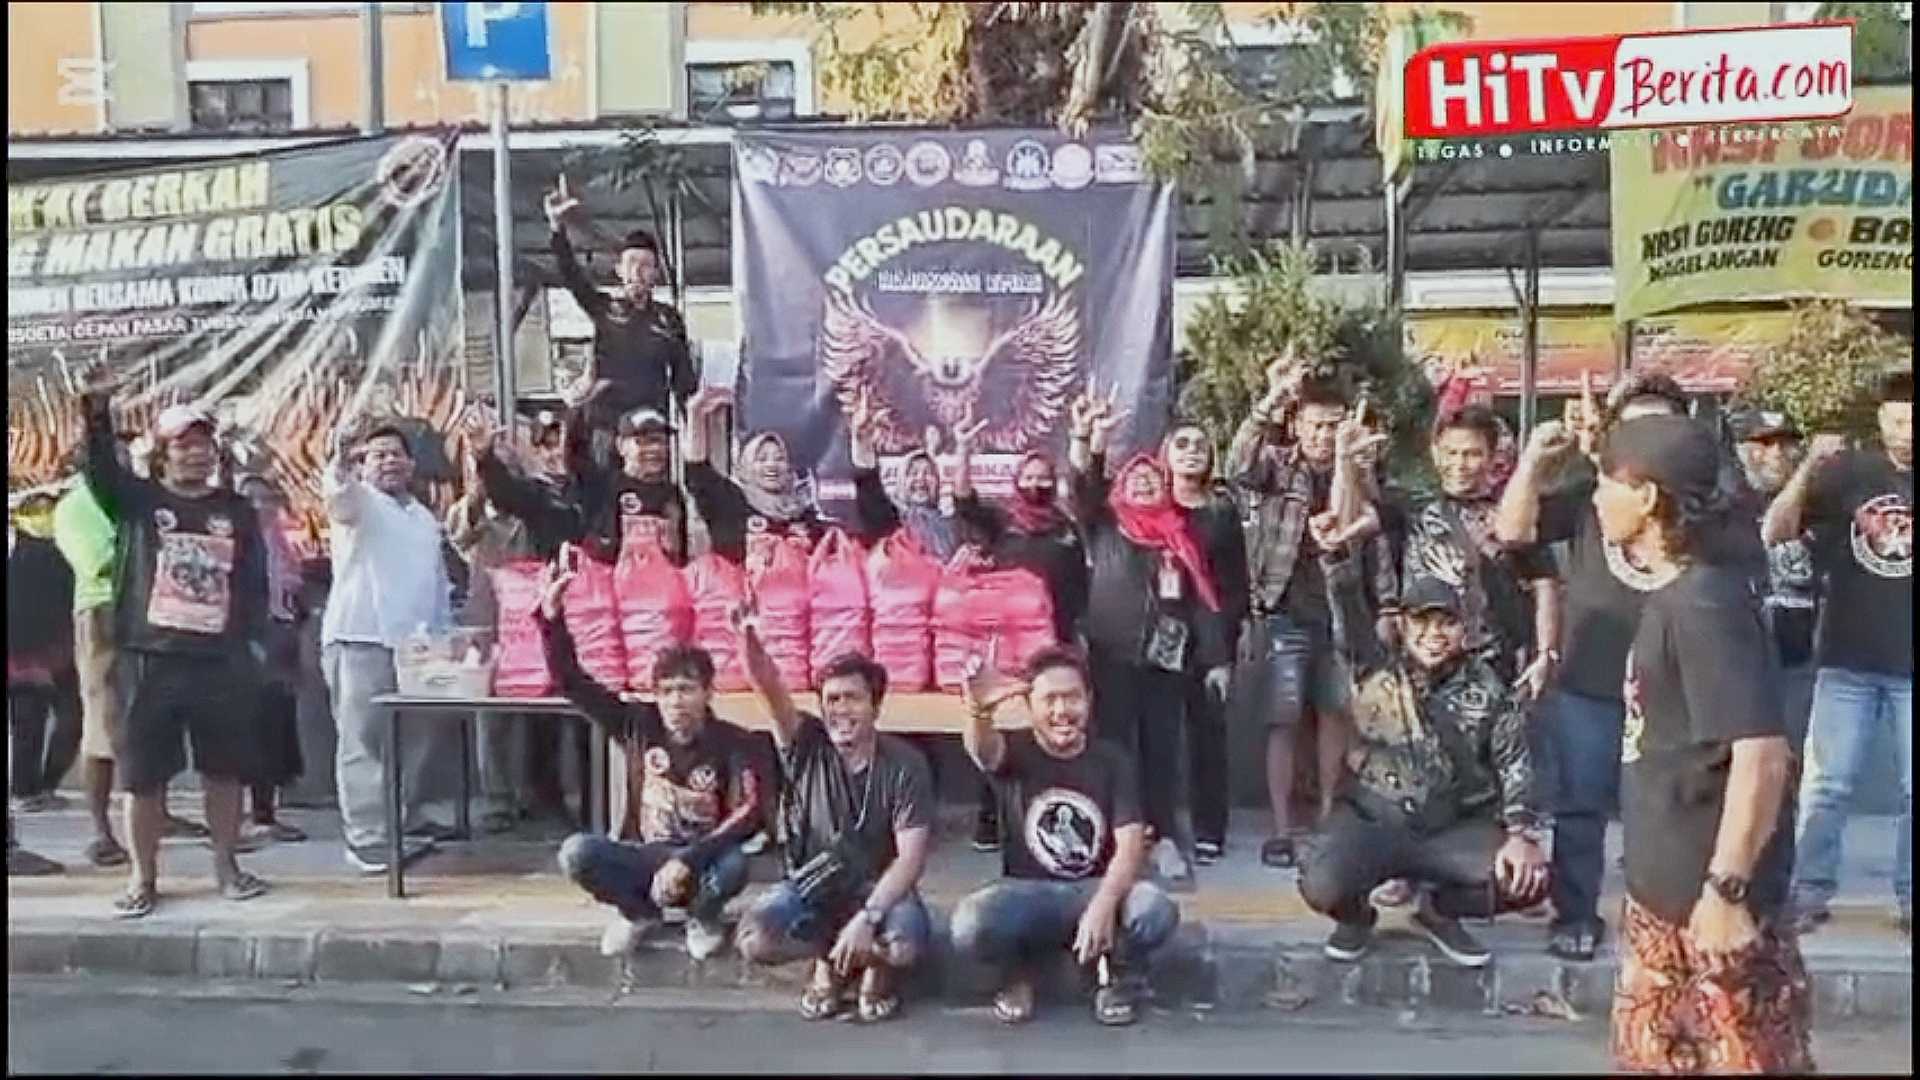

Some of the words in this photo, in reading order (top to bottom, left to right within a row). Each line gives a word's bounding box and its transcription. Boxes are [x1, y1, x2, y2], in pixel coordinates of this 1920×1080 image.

[43, 224, 198, 274] MAKAN
[203, 202, 363, 260] GRATIS
[824, 206, 1084, 293] PERSAUDARAAN
[1696, 216, 1796, 247] GORENG
